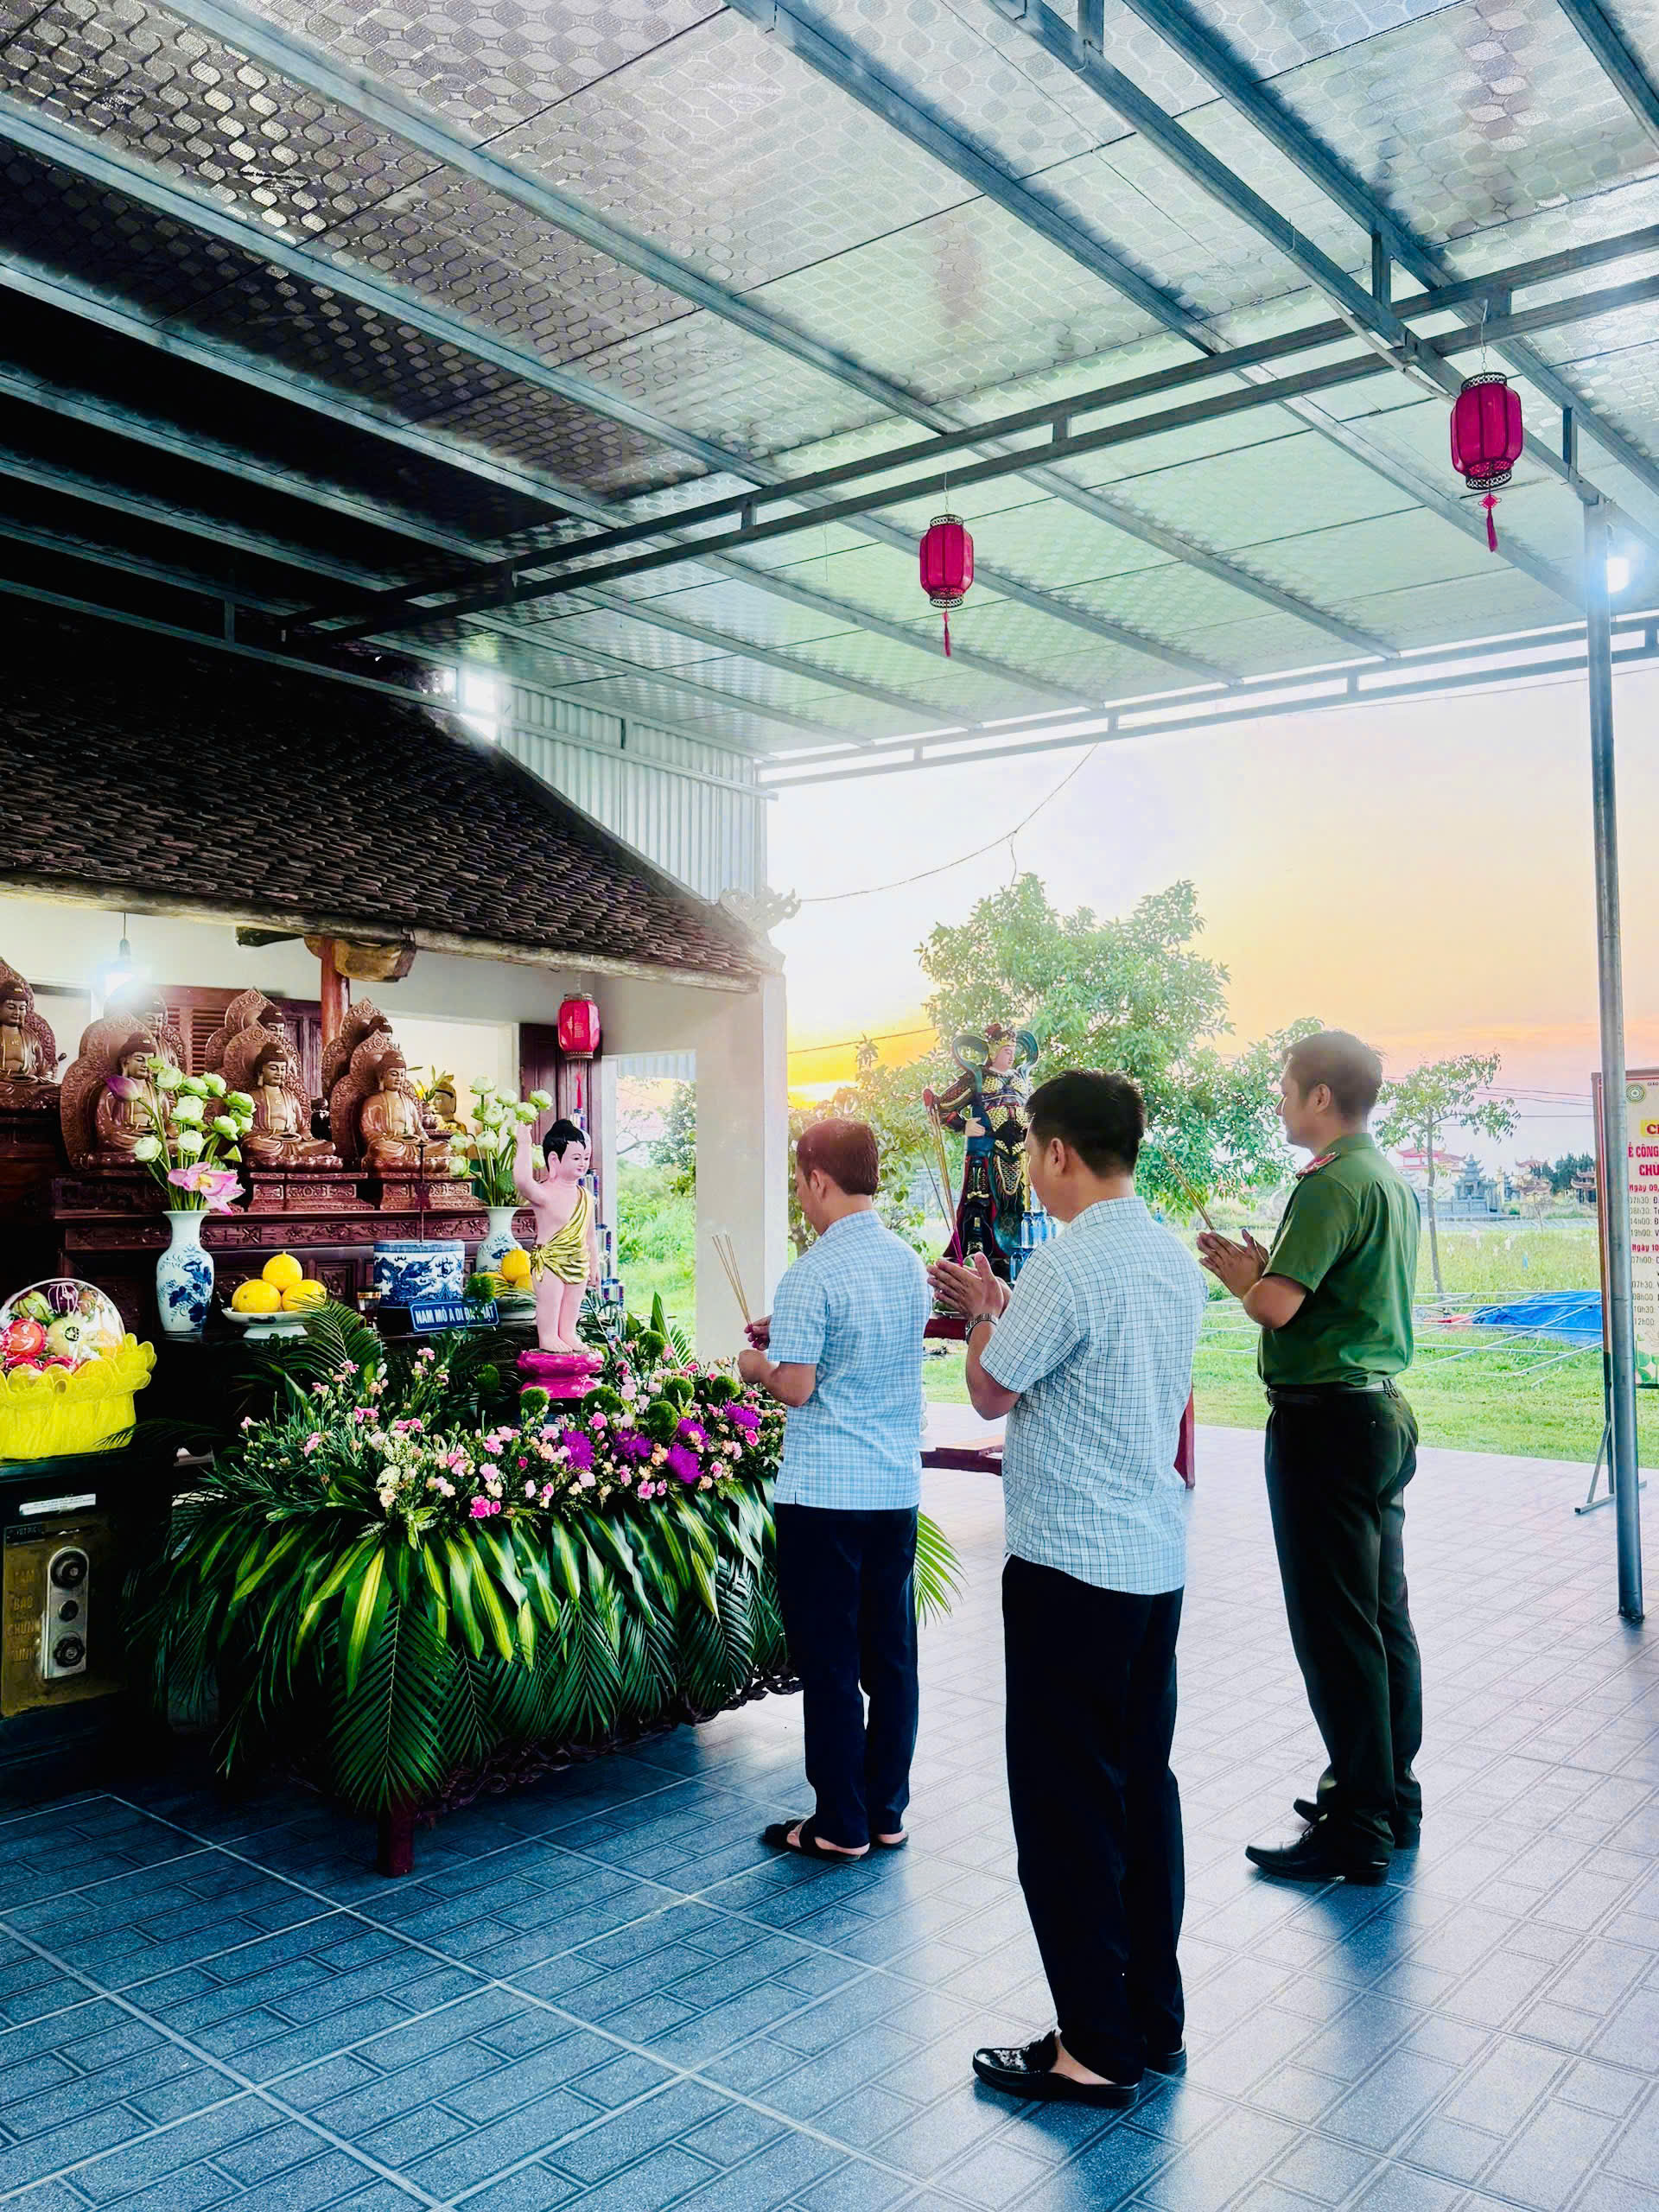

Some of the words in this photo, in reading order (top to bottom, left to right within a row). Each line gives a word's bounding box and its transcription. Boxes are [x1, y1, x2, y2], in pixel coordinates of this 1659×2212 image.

[415, 1309, 435, 1324] NAM
[434, 1306, 448, 1323] MÔ
[448, 1308, 455, 1322] A
[454, 1307, 464, 1321] DI
